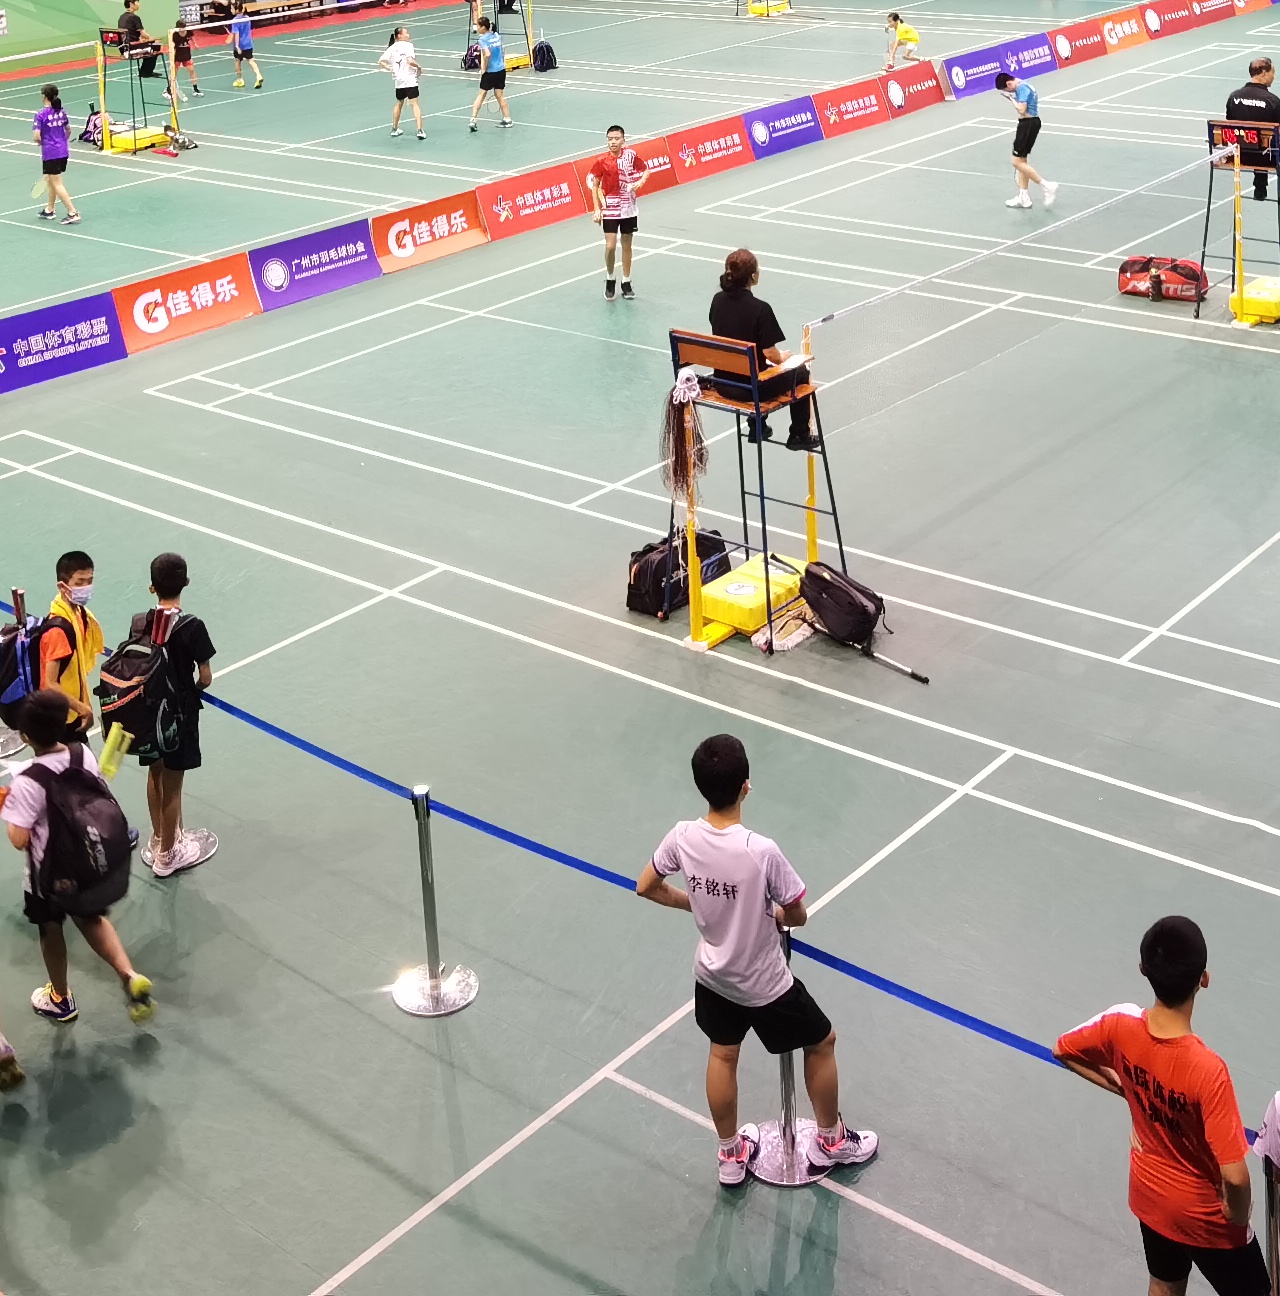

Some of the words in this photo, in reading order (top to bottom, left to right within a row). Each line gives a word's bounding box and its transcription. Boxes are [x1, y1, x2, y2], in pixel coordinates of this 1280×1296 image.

[697, 133, 741, 155] 中国体育彩票
[515, 182, 570, 208] 中国体育彩票
[387, 218, 416, 258] G
[413, 209, 468, 245] 佳得乐
[291, 240, 366, 272] 广州市羽毛球协会
[133, 288, 170, 334] G
[166, 275, 239, 317] 佳得乐
[13, 317, 108, 356] 中国体育彩票
[687, 874, 739, 900] 李铭轩
